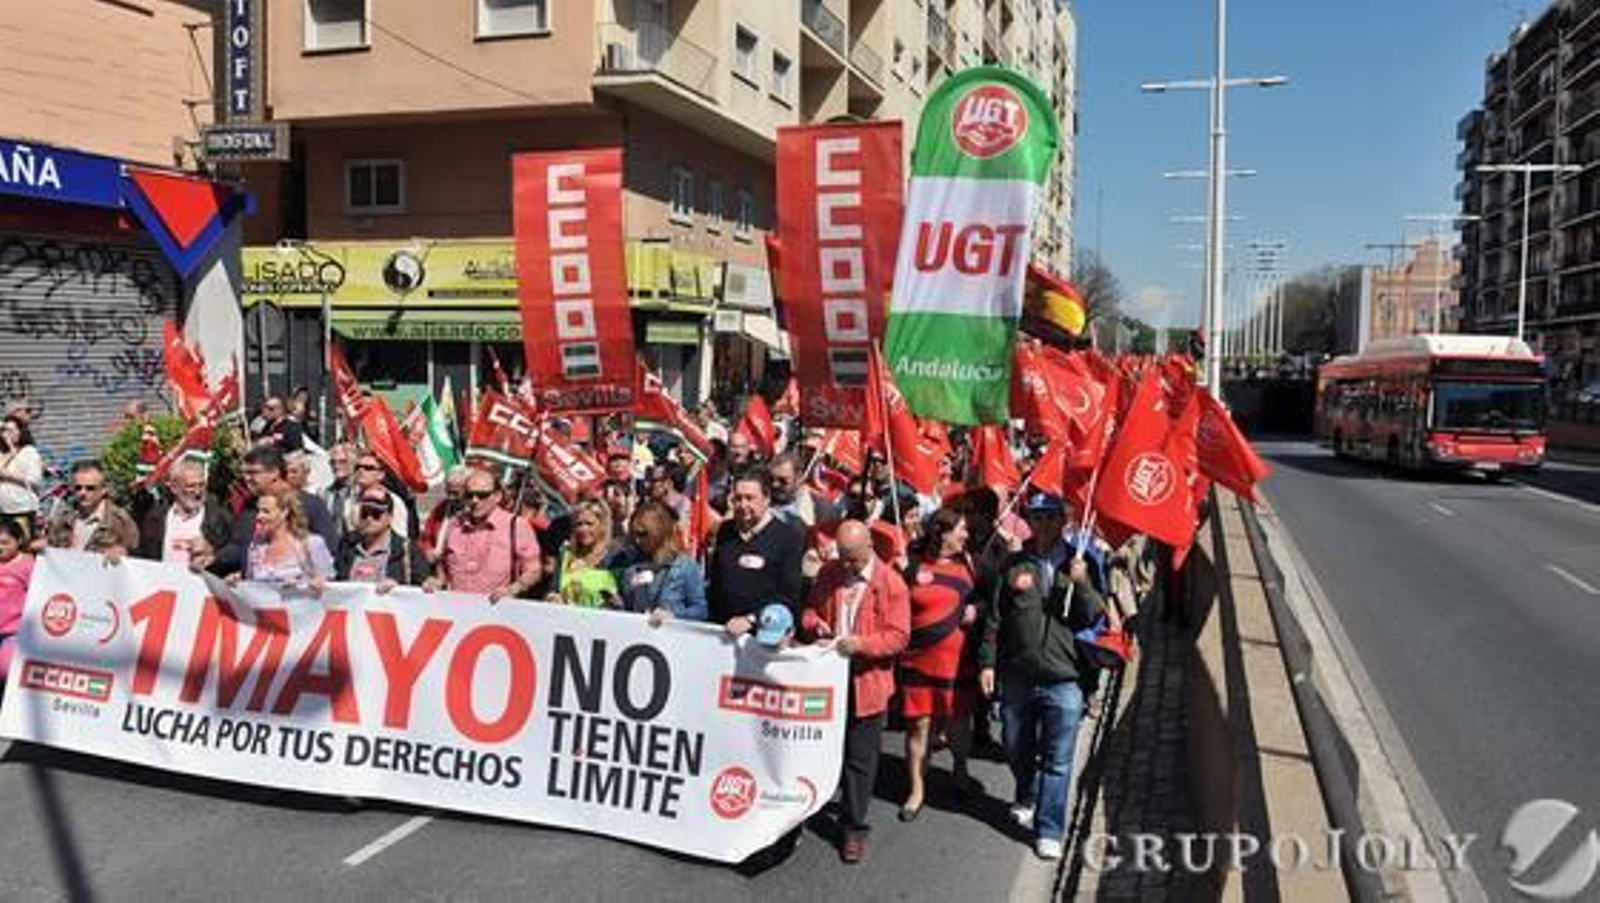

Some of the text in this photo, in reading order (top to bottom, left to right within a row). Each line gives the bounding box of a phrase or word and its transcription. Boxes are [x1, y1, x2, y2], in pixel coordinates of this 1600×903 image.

[207, 133, 273, 149] OSTAL
[961, 97, 1019, 127] UGT
[547, 163, 597, 340] CCOO
[816, 137, 869, 342] CCOO
[913, 221, 1027, 277] UGT
[547, 634, 672, 722] NO
[122, 703, 523, 789] LUCHA POR TUS DERECHOS
[547, 710, 705, 777] TIENEN
[761, 719, 824, 741] Sevilla
